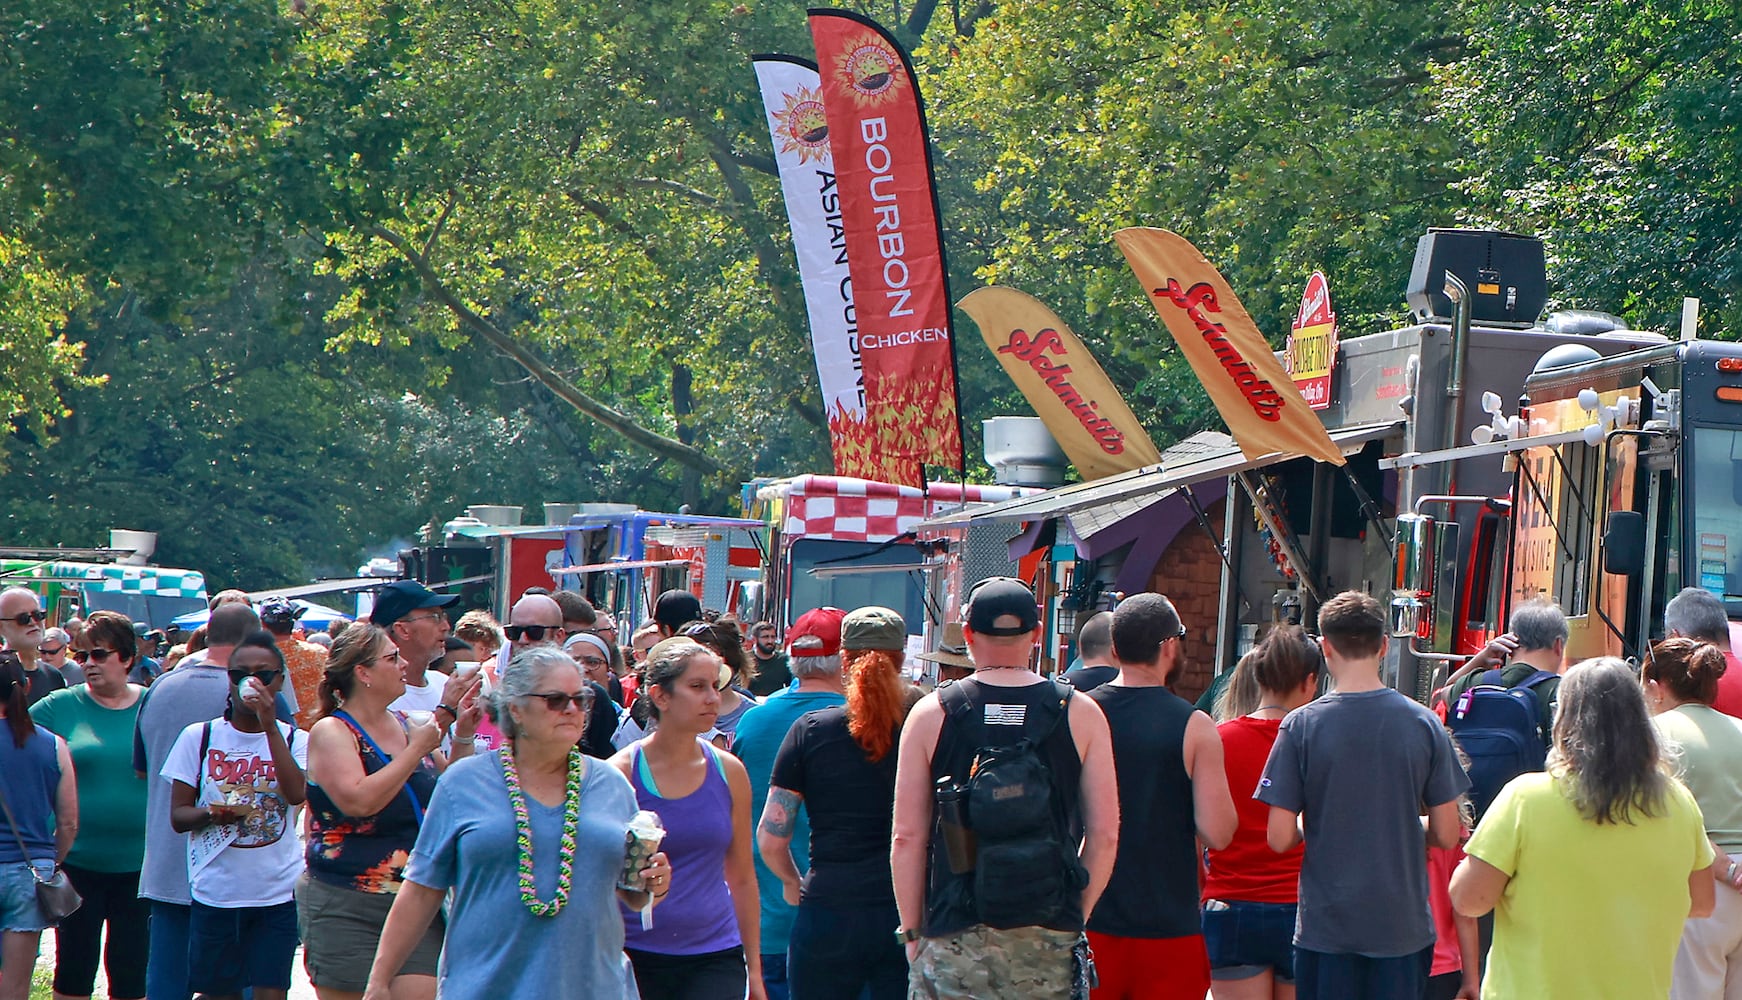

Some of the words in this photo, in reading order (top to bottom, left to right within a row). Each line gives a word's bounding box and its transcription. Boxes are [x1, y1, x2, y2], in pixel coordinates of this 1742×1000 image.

[816, 169, 849, 265] ASIAN
[860, 117, 915, 318] BOURBON
[861, 327, 949, 349] CHICKEN
[997, 328, 1125, 455] Schmidt's
